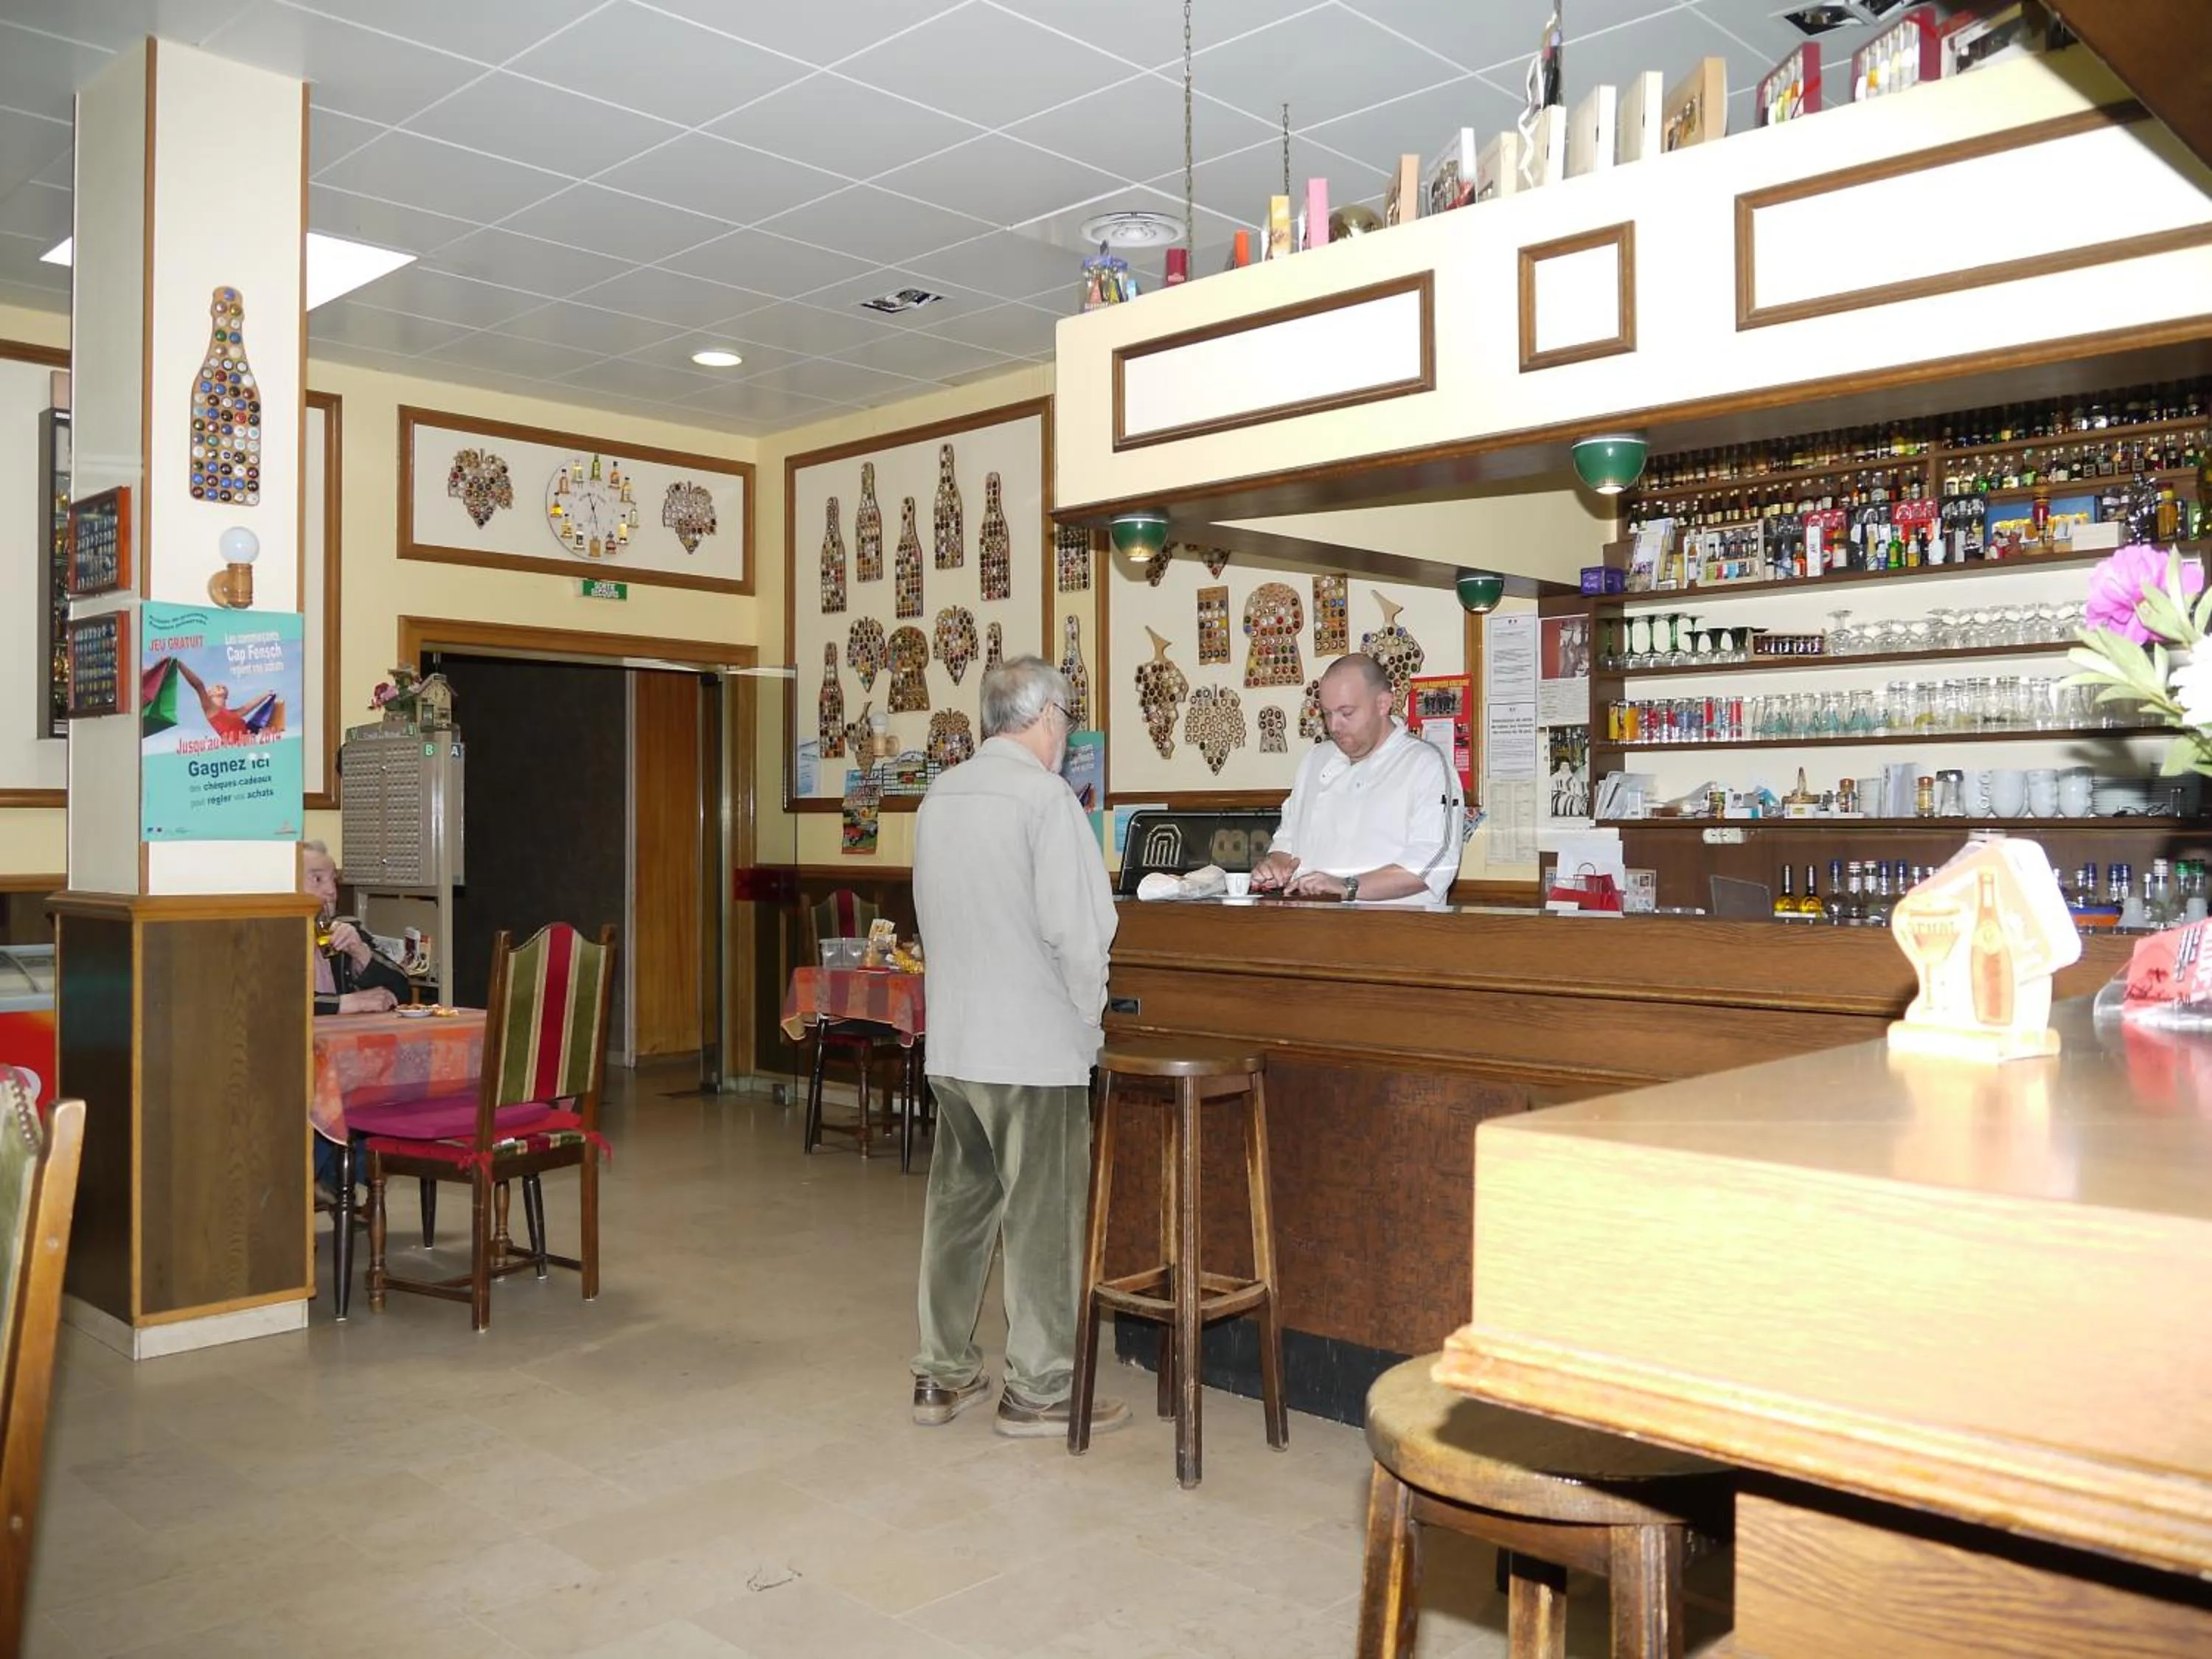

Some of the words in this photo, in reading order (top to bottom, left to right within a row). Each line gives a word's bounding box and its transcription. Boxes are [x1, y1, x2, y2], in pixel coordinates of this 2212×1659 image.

[150, 639, 165, 651] JEU
[168, 636, 203, 649] GRATUIT
[226, 645, 246, 664] Cap
[177, 737, 219, 756] Jusqu'au
[425, 743, 434, 757] B
[451, 745, 459, 757] A
[188, 759, 247, 778] Gagnez
